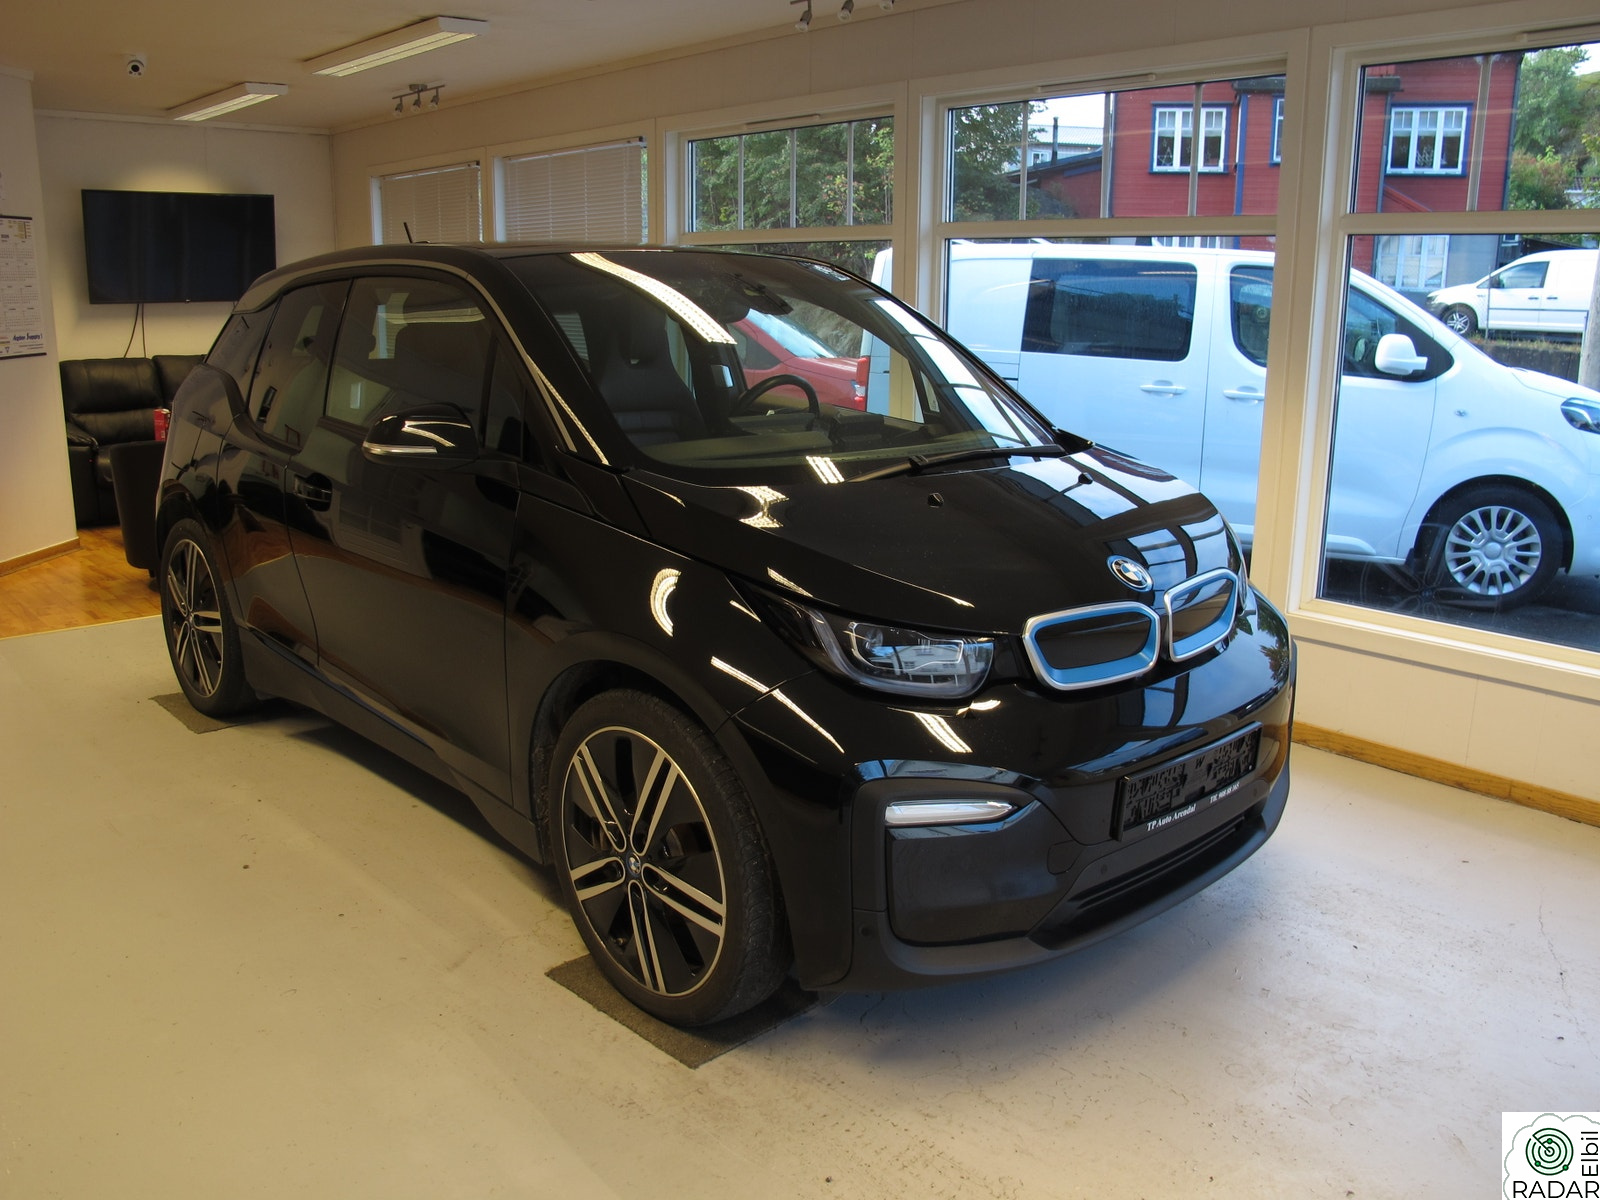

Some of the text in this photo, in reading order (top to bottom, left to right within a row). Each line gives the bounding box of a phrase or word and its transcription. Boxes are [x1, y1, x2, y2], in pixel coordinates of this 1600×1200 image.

[1146, 803, 1196, 831] TP Auto Arendal
